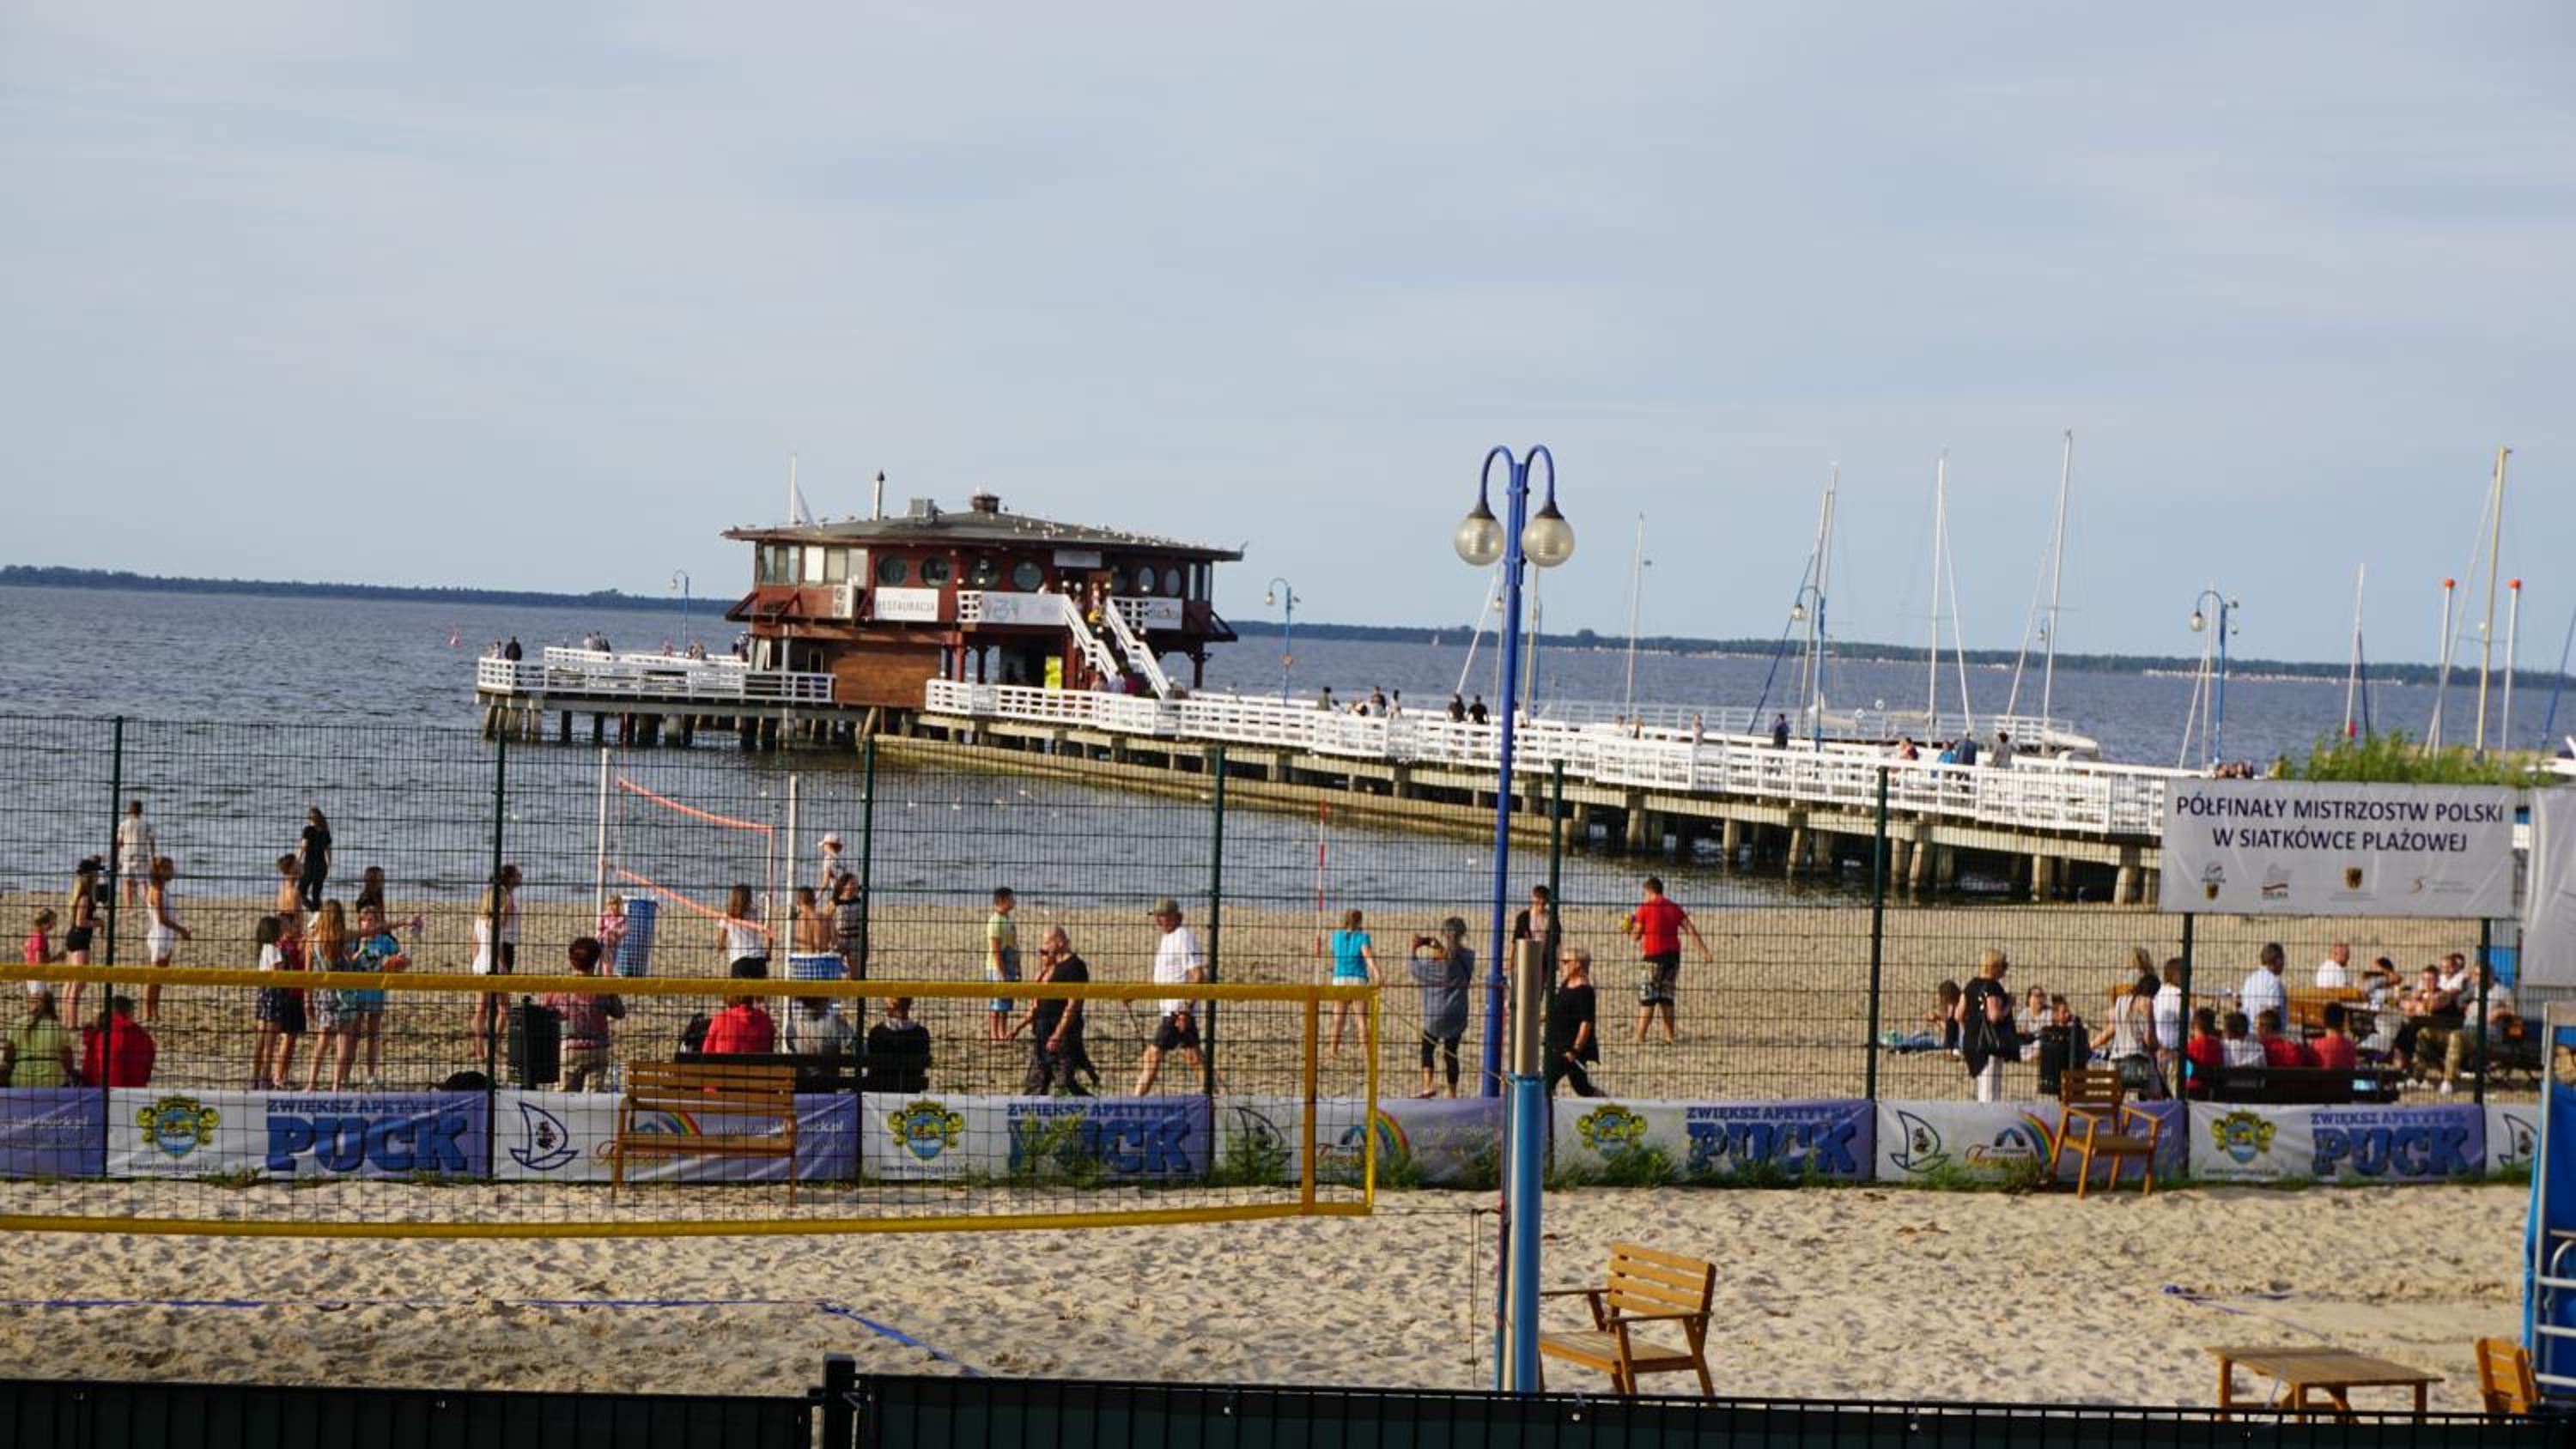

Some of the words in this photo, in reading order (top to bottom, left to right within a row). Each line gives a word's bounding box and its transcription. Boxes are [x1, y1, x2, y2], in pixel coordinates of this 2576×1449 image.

[2177, 791, 2287, 817] PÓŁFINAŁY
[2293, 799, 2429, 822] MISTRZOSTW
[2435, 803, 2503, 822] POLSKI
[2213, 827, 2233, 847] W
[2239, 825, 2356, 850] SIATKÓWCE
[2362, 828, 2467, 852] PLAŻOWEJ
[267, 1117, 469, 1172] PUCK
[1687, 1122, 1856, 1173] PUCK
[2312, 1127, 2470, 1176] PUCK
